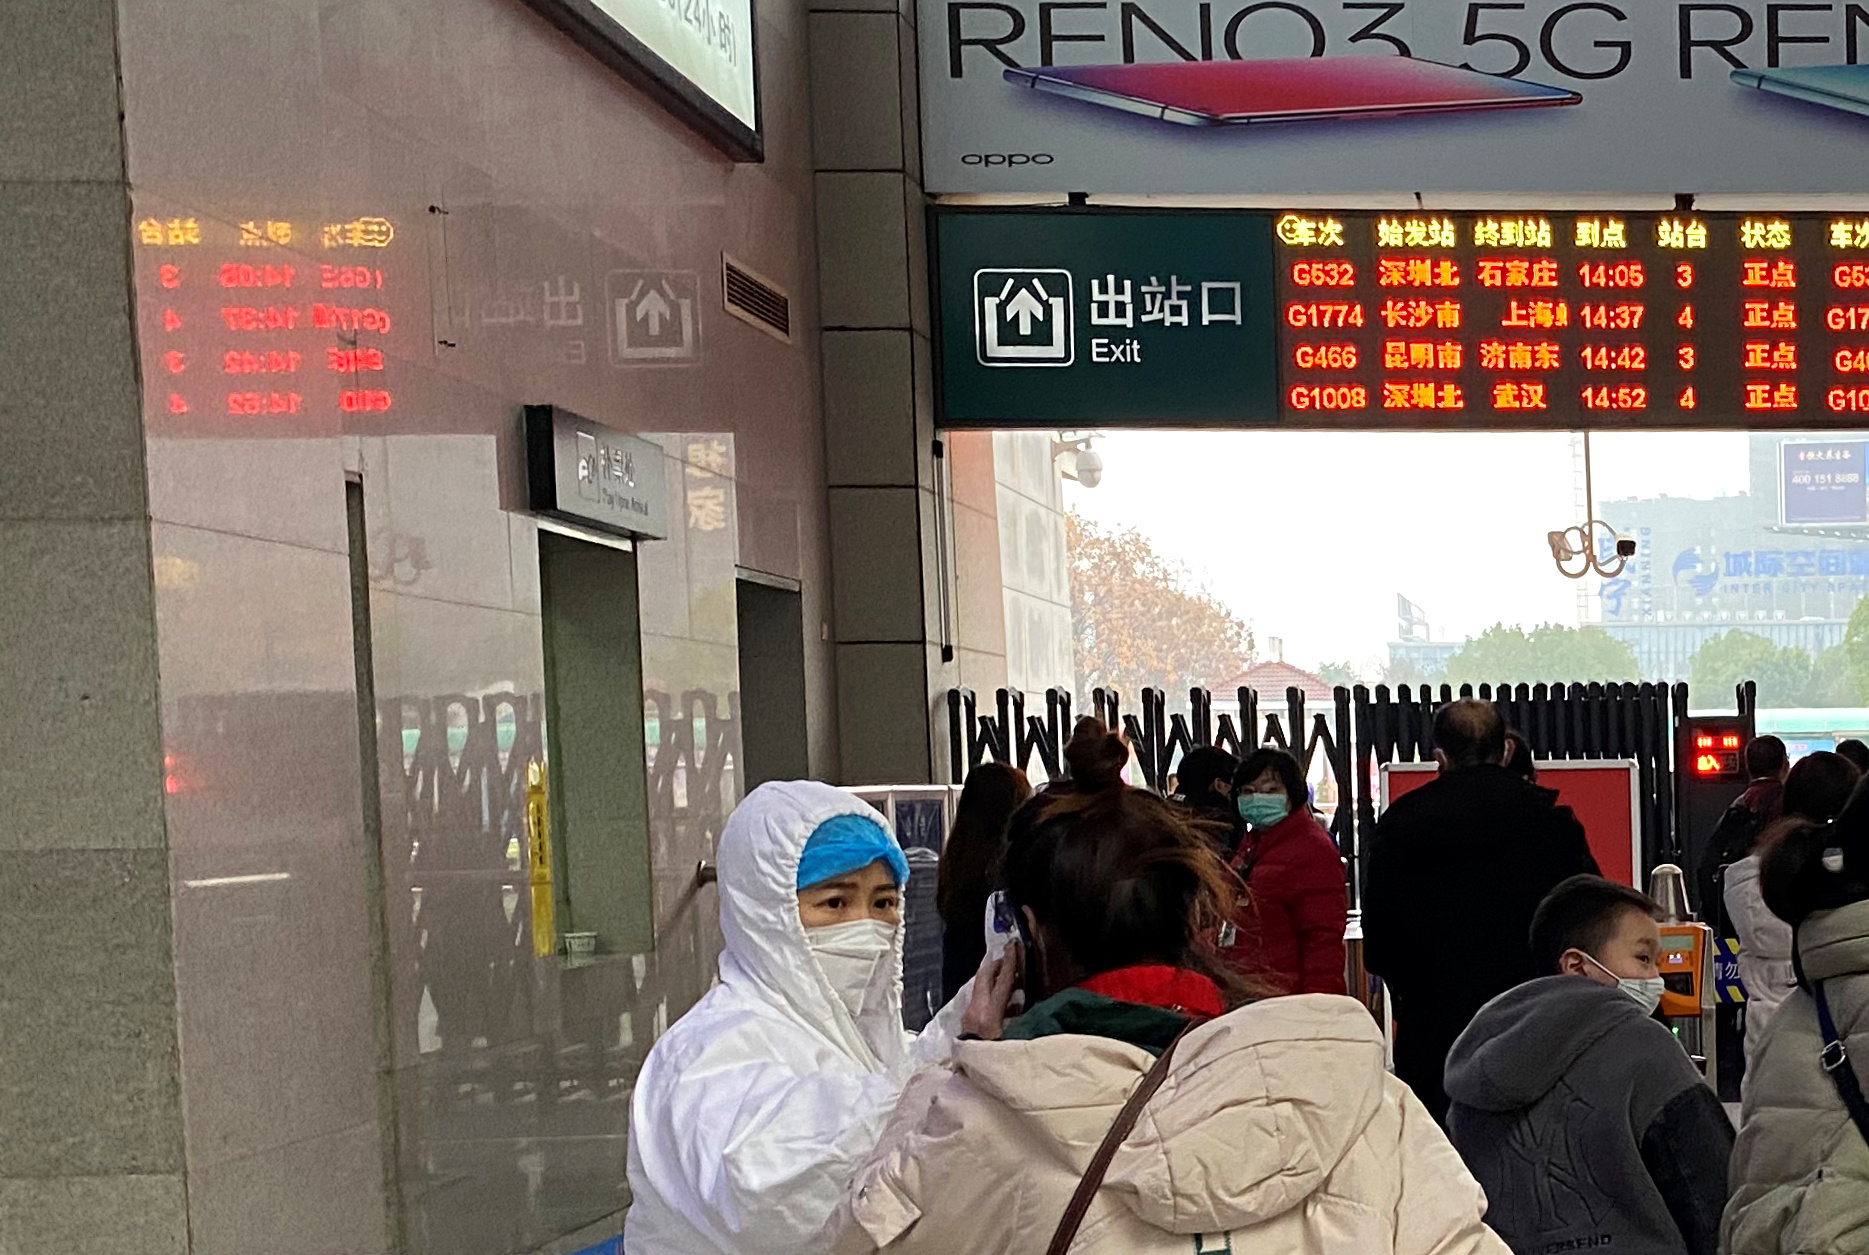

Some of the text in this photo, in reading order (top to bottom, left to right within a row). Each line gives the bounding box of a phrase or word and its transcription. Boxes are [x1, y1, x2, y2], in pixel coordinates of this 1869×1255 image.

[1459, 2, 1633, 80] 5G
[1377, 216, 1456, 248] 始发站
[1474, 217, 1551, 248] 终到站
[1574, 217, 1627, 249] 到点
[1657, 218, 1707, 249] 站台
[1740, 218, 1791, 249] 状态
[1291, 260, 1356, 287] G532
[1378, 256, 1462, 288] 深圳北
[1477, 256, 1559, 288] 石家庄
[1578, 261, 1646, 288] 14:05
[1676, 261, 1695, 288] 3
[1741, 258, 1797, 289] 正点
[1090, 274, 1242, 328] 出站口
[1286, 301, 1366, 328] G1774
[1379, 297, 1463, 329] 长沙南
[1579, 302, 1645, 329] 14:37
[1676, 303, 1694, 329] 4
[1743, 299, 1798, 330] 正点
[1091, 338, 1142, 363] Exit
[1294, 343, 1360, 370] G466
[1382, 338, 1465, 370] 昆明南
[1479, 338, 1561, 370] 济南东
[1580, 344, 1647, 371] 14:42
[1677, 344, 1695, 370] 3
[1743, 340, 1798, 371] 正点
[1288, 384, 1369, 411] G1008
[1380, 379, 1465, 411] 深圳北
[1491, 380, 1548, 410] 武汉
[1581, 385, 1648, 411] 14:52
[1679, 386, 1696, 410] 4
[1744, 381, 1798, 411] 正点
